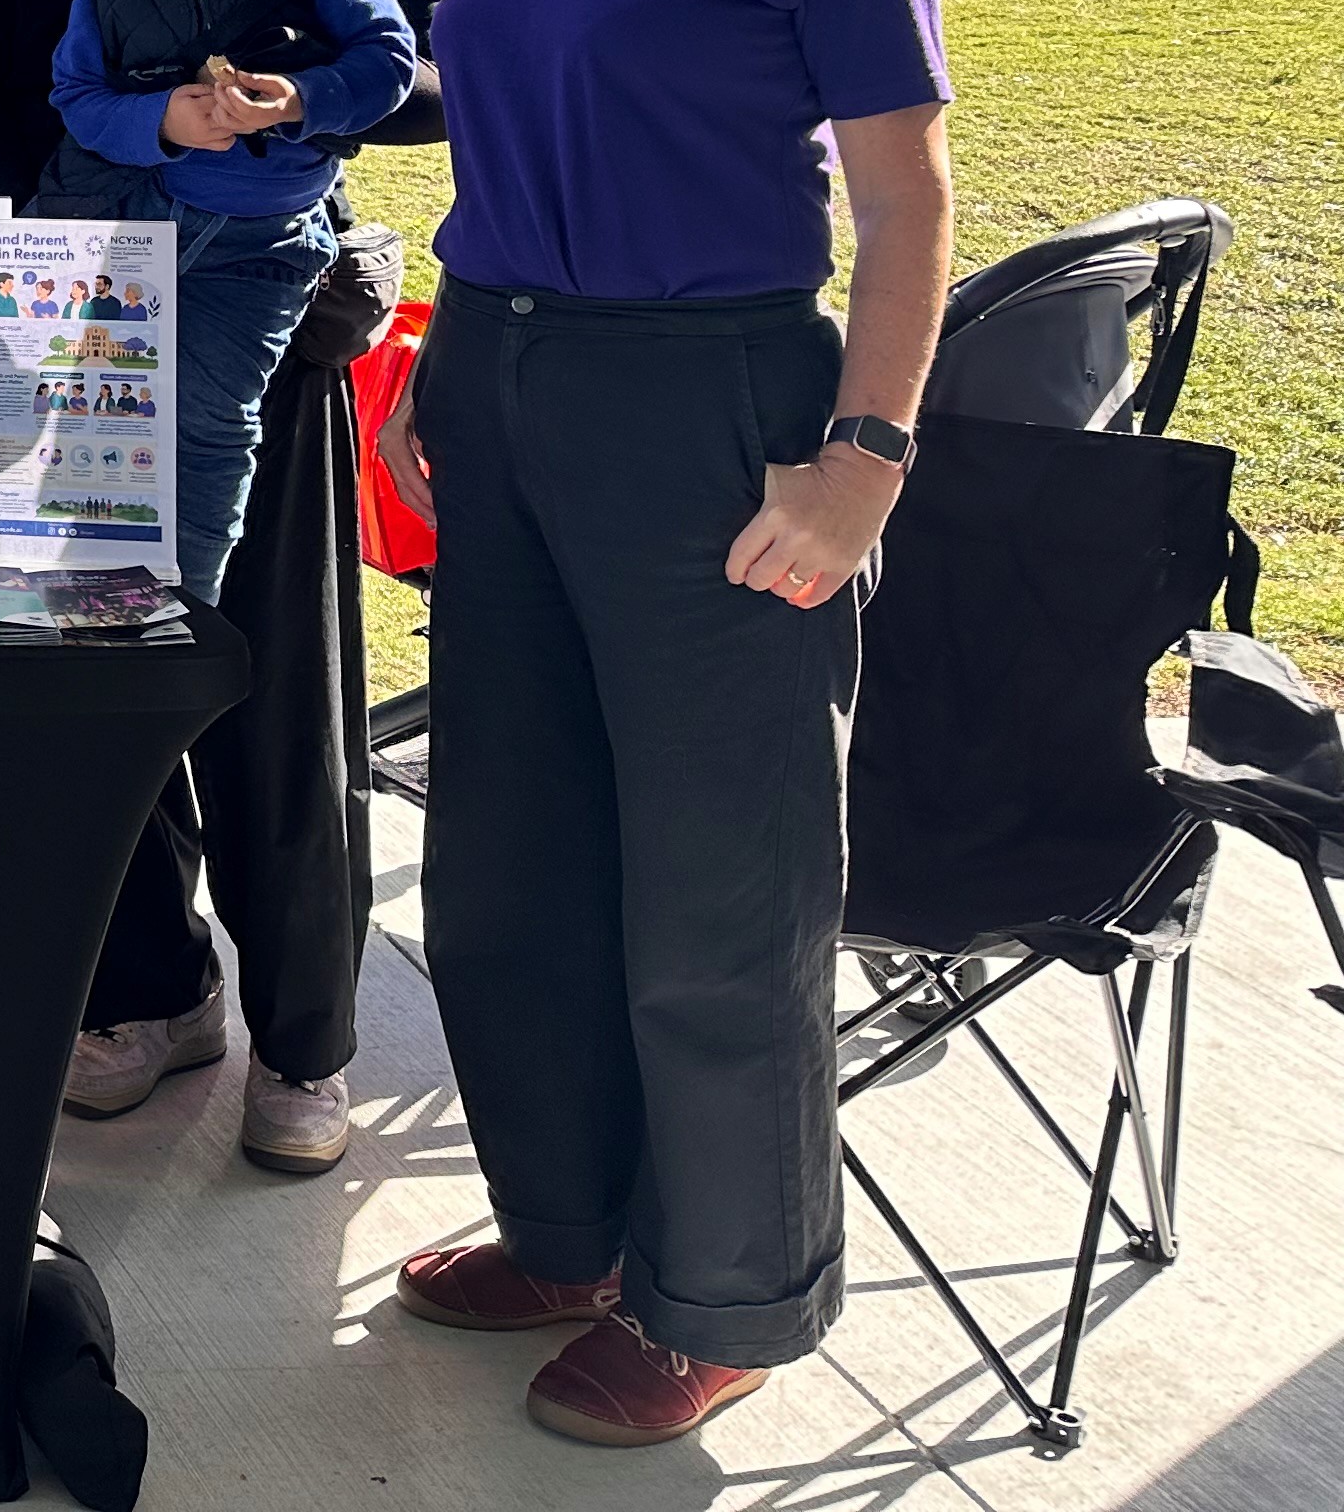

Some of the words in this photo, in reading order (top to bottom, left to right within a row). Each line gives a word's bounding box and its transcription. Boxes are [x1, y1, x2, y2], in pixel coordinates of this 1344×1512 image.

[24, 233, 68, 246] Parent
[111, 236, 152, 245] NCYSUR
[15, 248, 74, 261] Research
